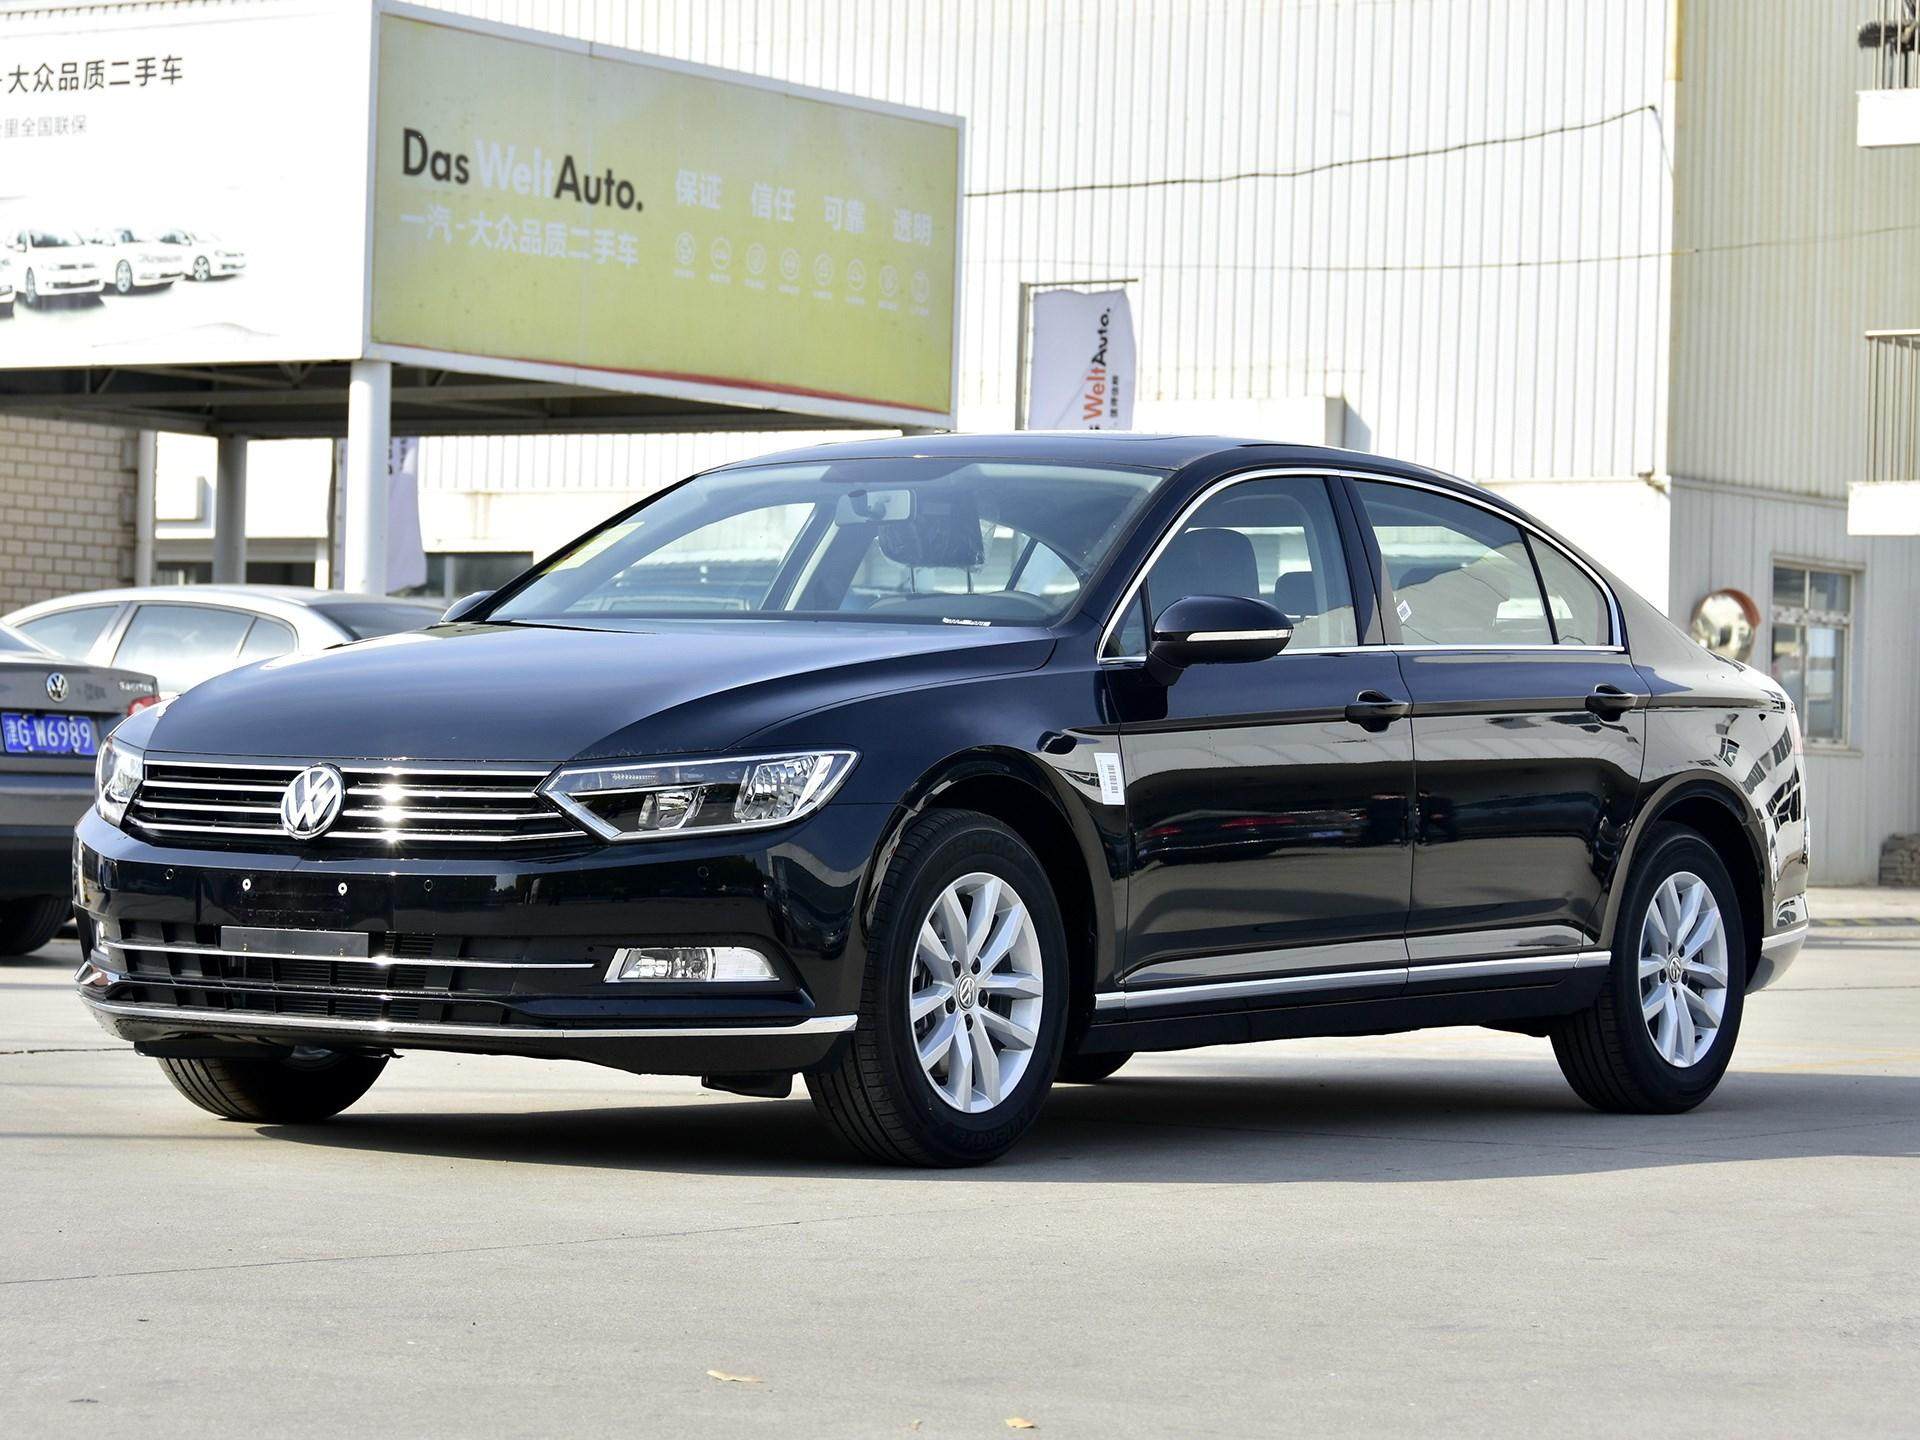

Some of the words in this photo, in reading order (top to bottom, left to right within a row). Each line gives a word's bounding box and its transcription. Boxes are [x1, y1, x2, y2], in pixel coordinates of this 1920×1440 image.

[0, 55, 183, 94] 大众品质二手车
[0, 114, 87, 138] 里全国联保
[402, 128, 470, 184] Das
[400, 203, 639, 268] 一汽-大众品质二手车
[675, 168, 722, 211] 保证
[751, 181, 796, 223] 信任
[823, 196, 865, 233] 可靠
[894, 207, 933, 247] 透明
